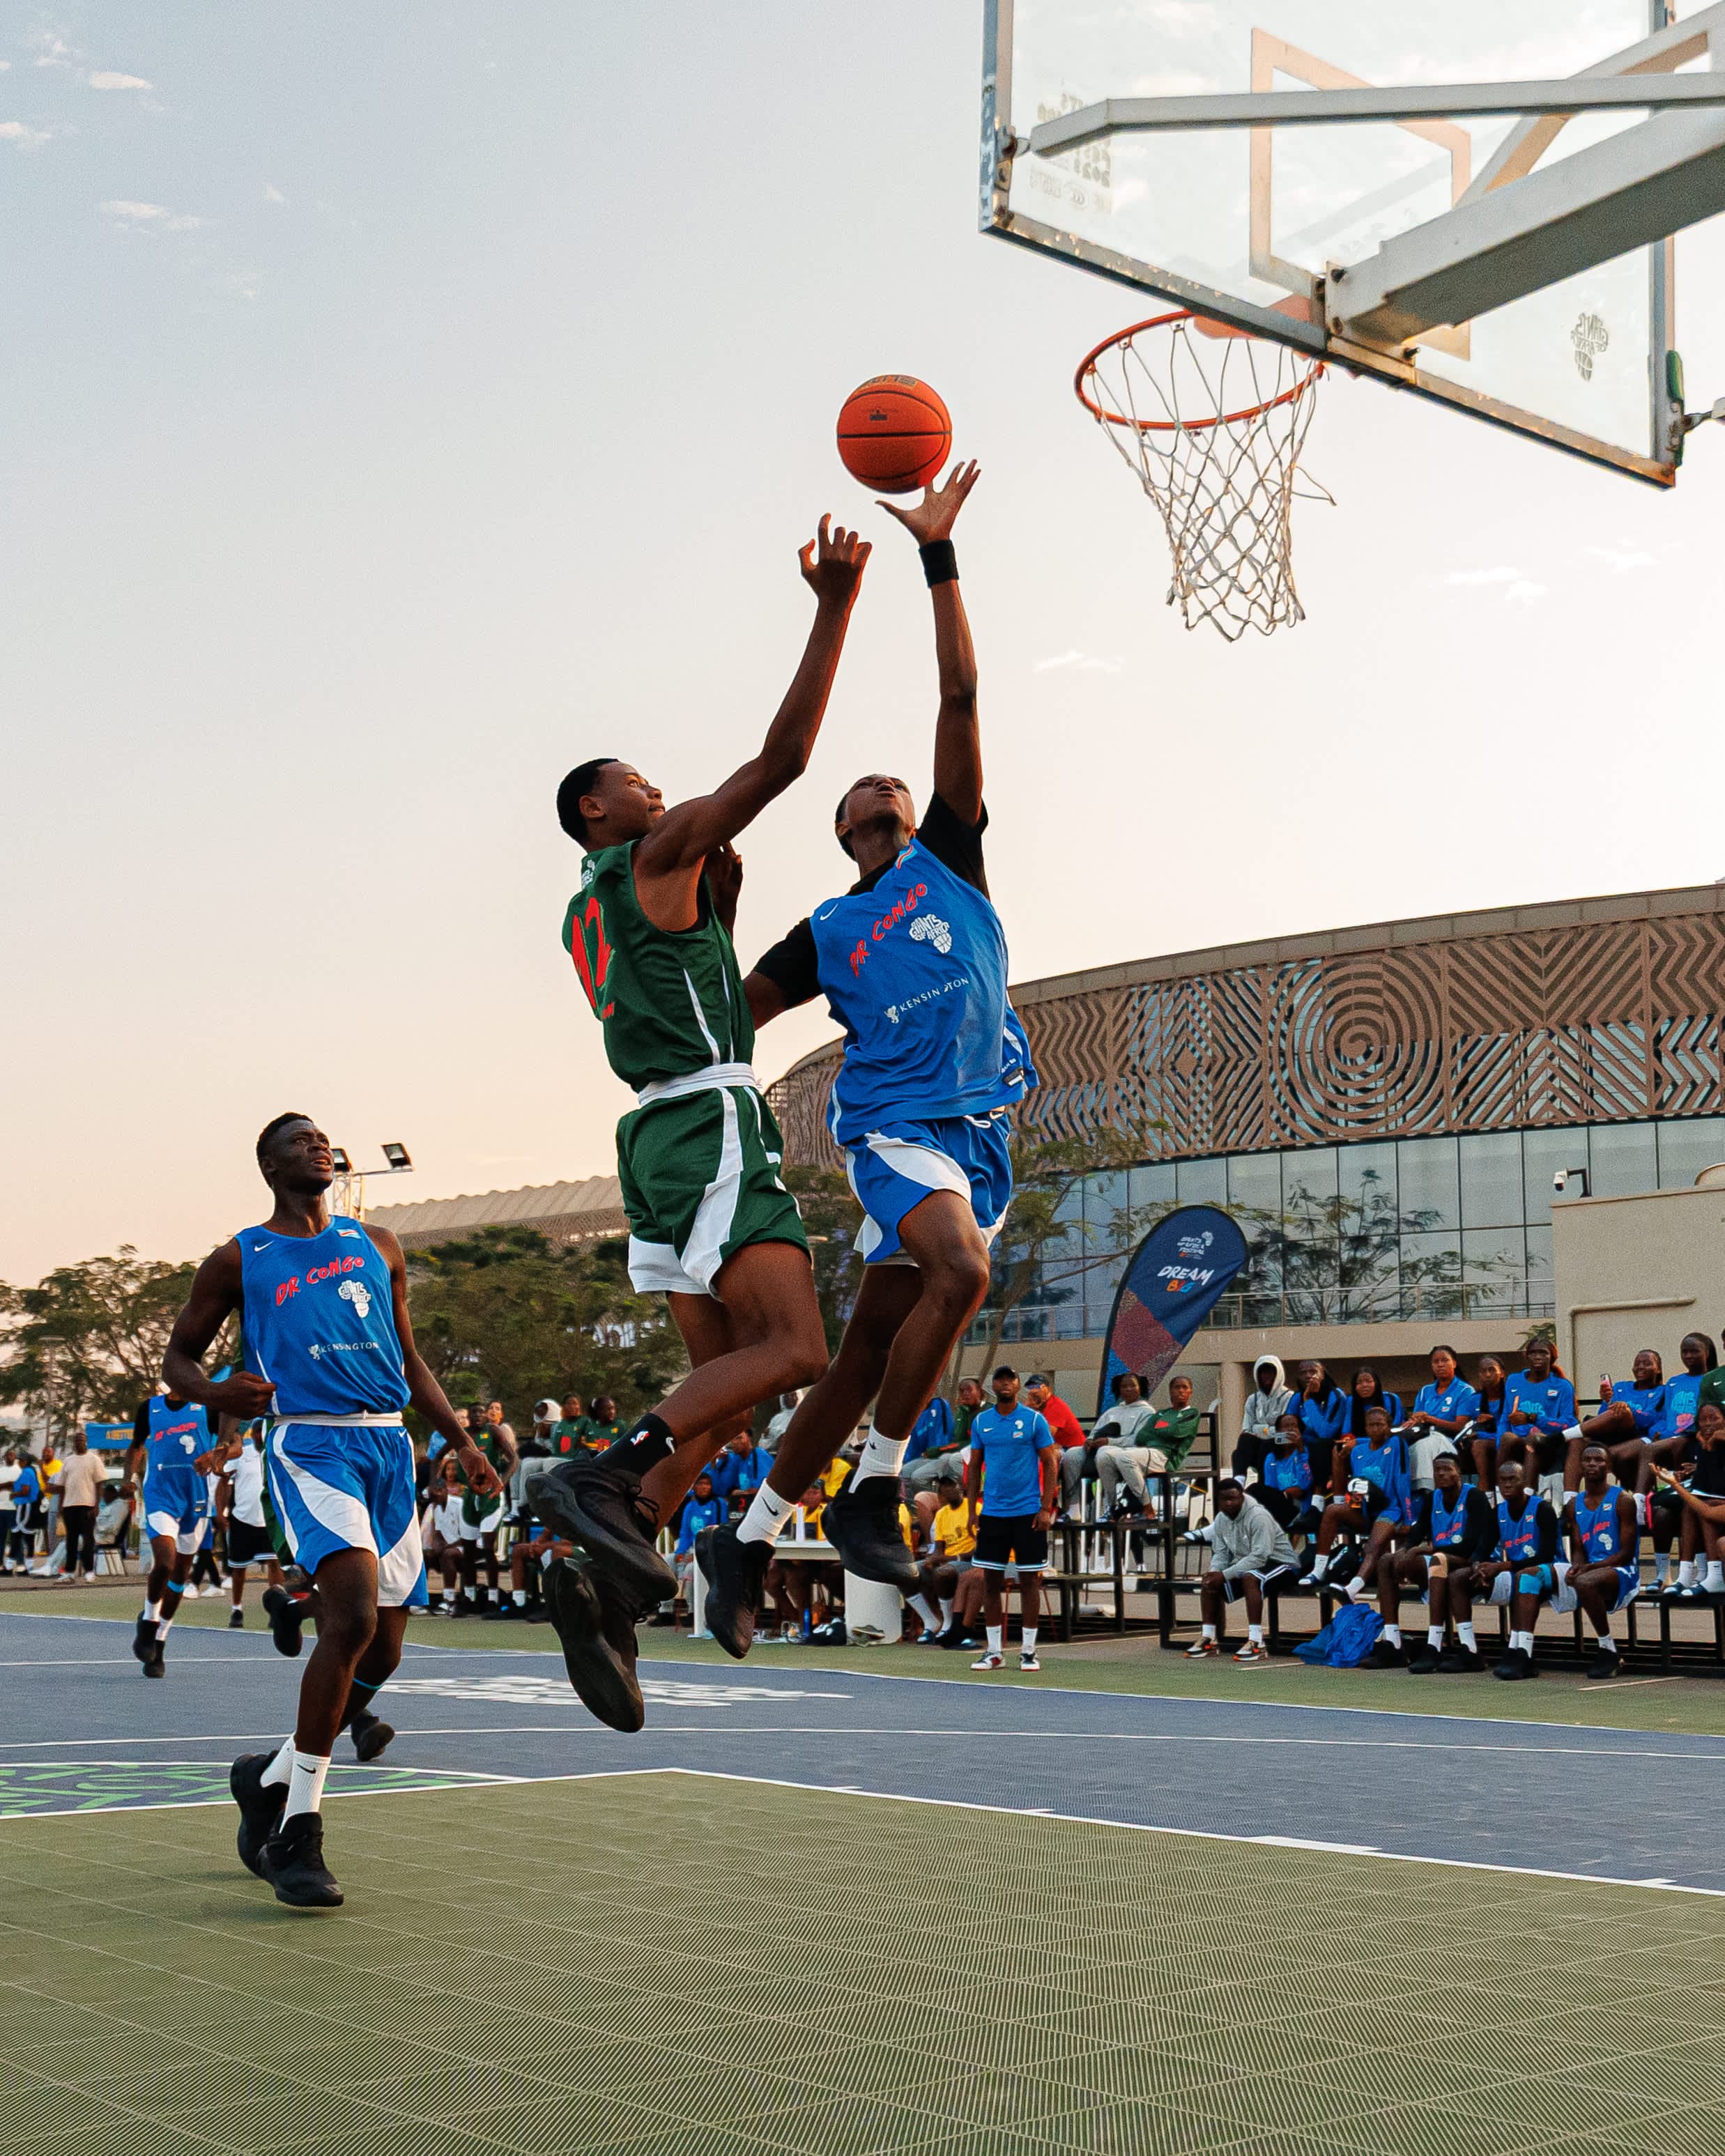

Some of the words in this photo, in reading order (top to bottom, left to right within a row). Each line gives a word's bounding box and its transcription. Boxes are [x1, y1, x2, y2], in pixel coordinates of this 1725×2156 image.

[872, 883, 928, 941] CONGO
[909, 914, 943, 939] GIANTS
[276, 1276, 302, 1307] DR
[306, 1256, 365, 1285] CONGO
[1157, 1265, 1214, 1286] DREAM
[1166, 1279, 1195, 1293] BIG
